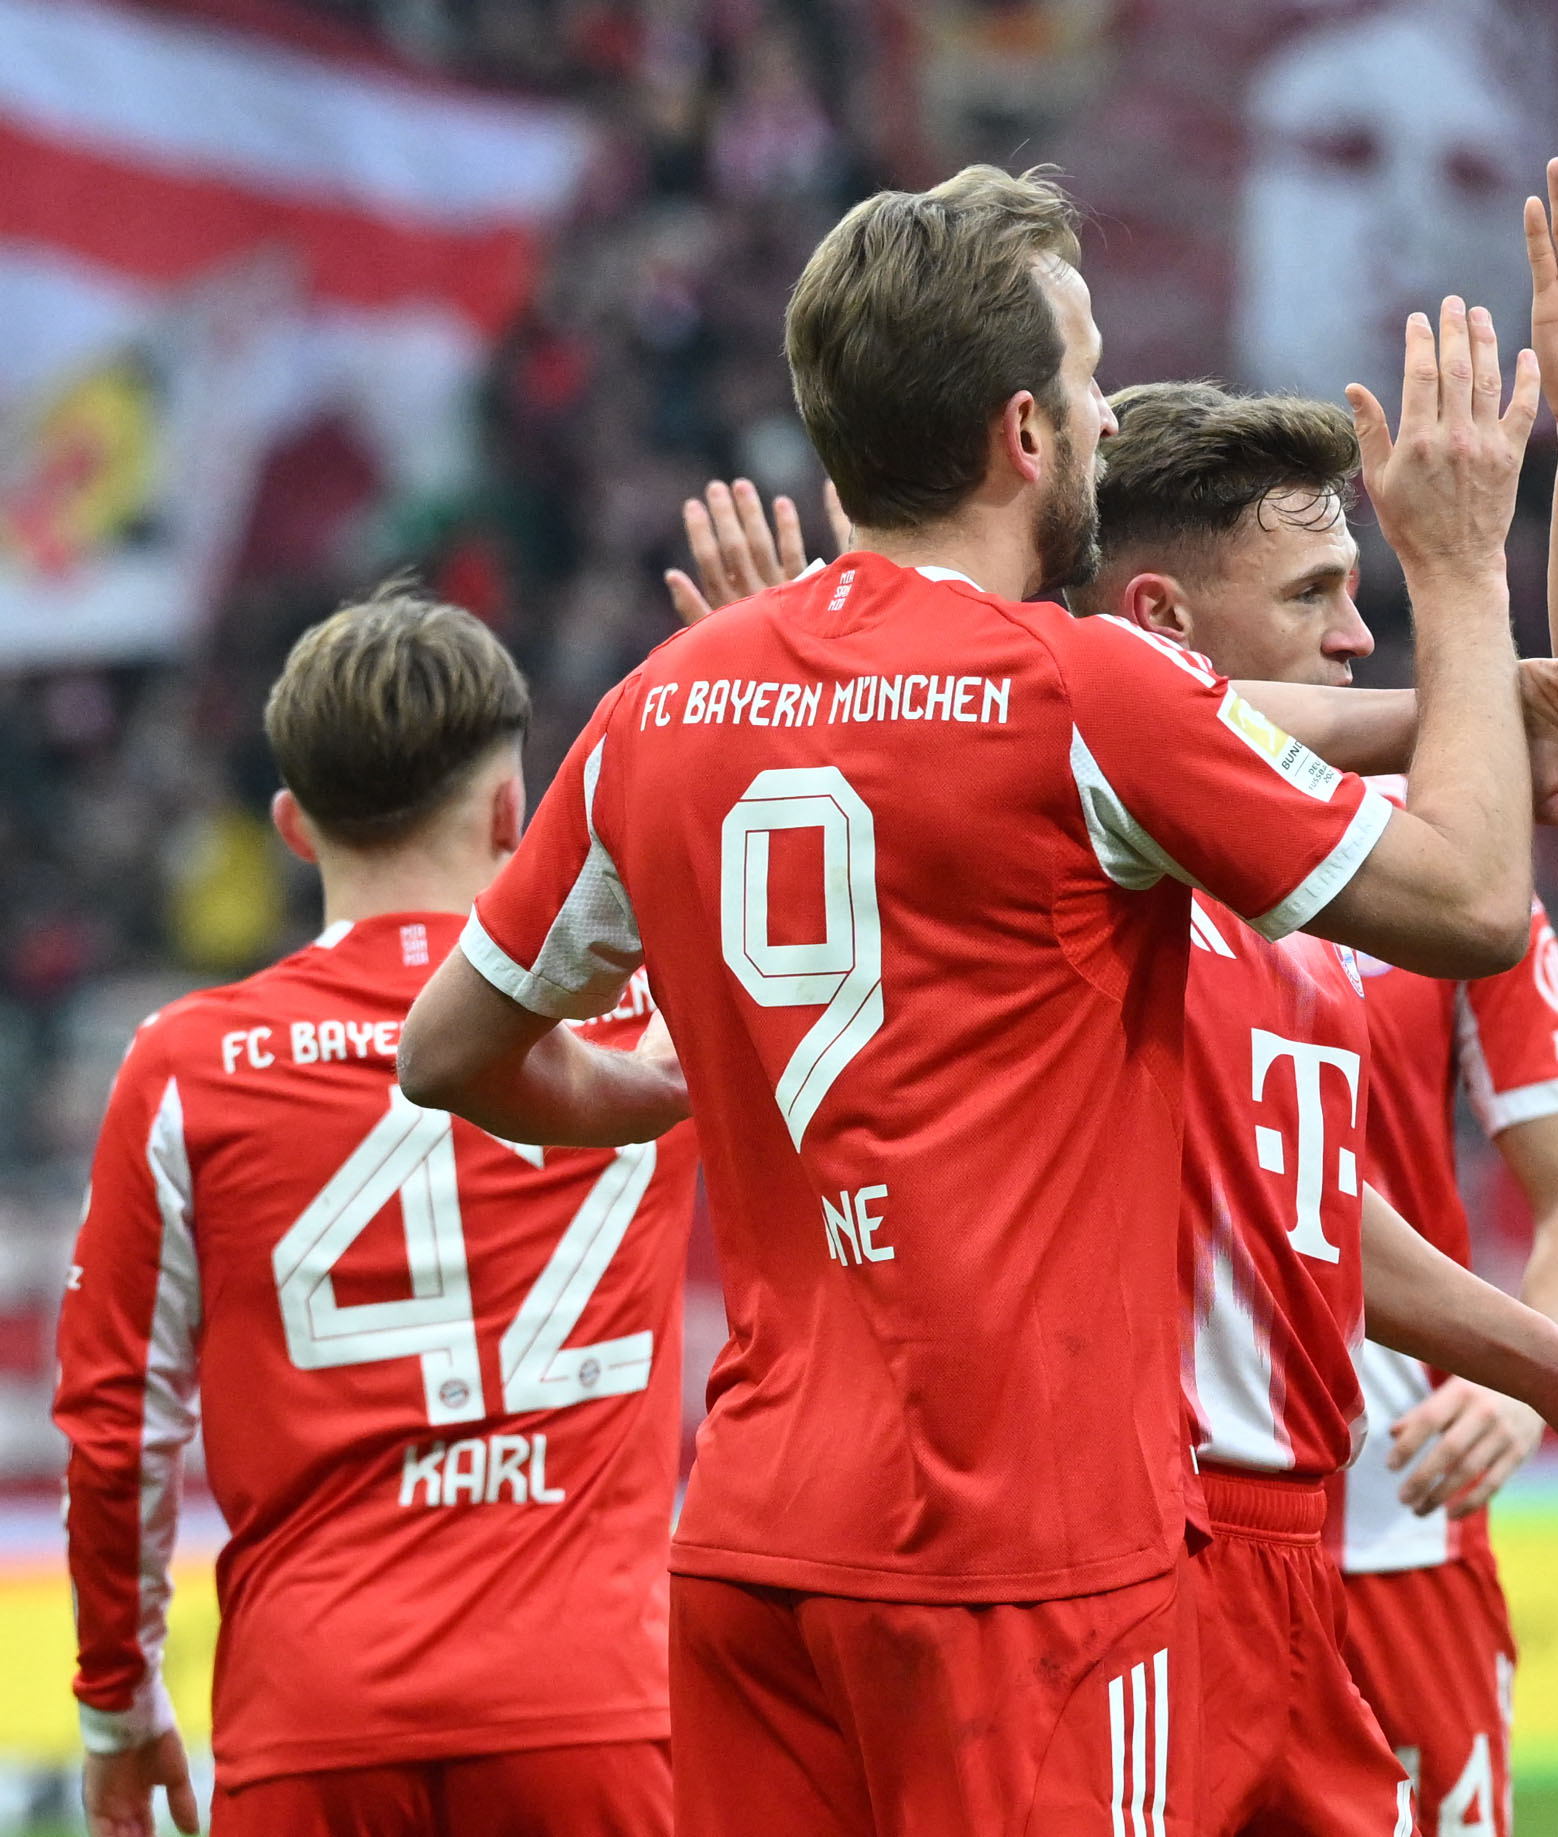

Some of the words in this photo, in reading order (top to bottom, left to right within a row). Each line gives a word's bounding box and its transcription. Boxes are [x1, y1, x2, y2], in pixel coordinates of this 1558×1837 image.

[640, 682, 679, 732] FC
[682, 679, 823, 728] BAYERN
[828, 674, 1012, 725] MÜNCHEN
[721, 766, 884, 1154] 9
[221, 1026, 275, 1075] FC
[290, 1020, 405, 1065] BAYE
[1250, 1027, 1360, 1264] T
[271, 1082, 658, 1427] 42
[398, 1433, 567, 1507] KARL
